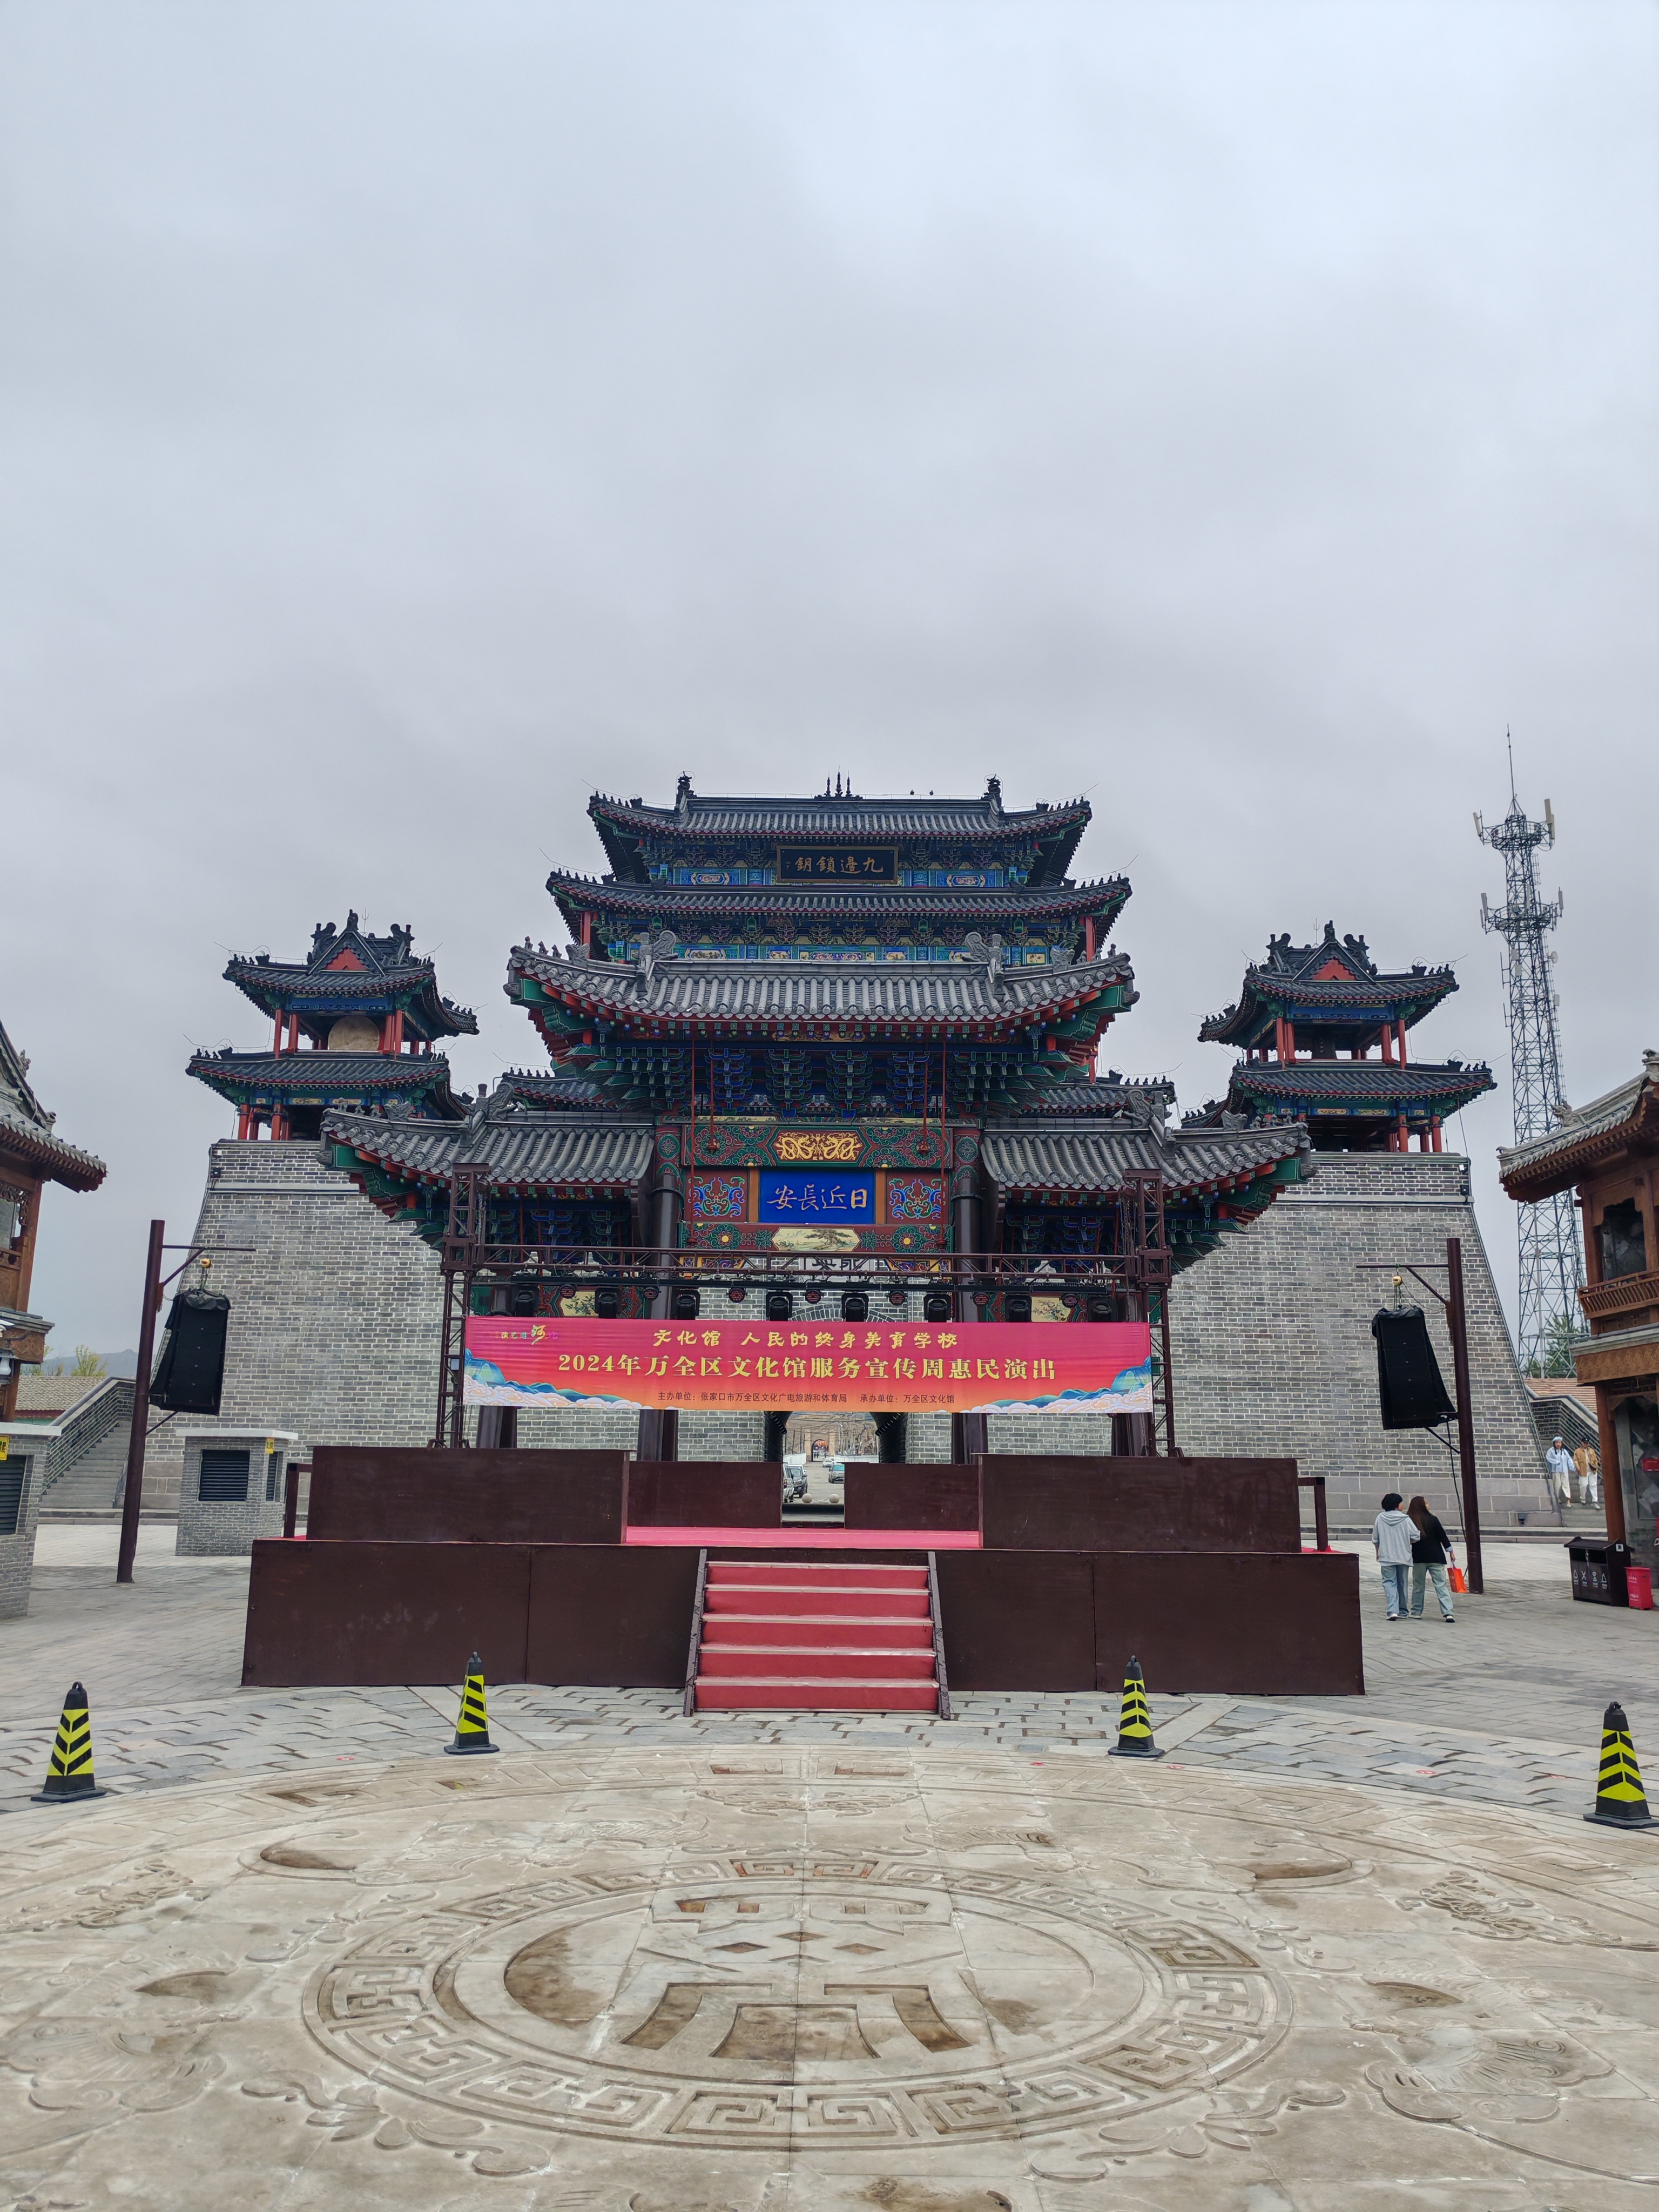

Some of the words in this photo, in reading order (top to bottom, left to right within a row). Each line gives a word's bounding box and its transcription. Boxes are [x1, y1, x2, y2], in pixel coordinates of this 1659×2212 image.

[653, 1329, 721, 1347] 文化馆
[740, 1331, 958, 1349] 人民的终身美育学校
[558, 1354, 1056, 1380] 2024年万全区文化馆服务宣传周惠民演出
